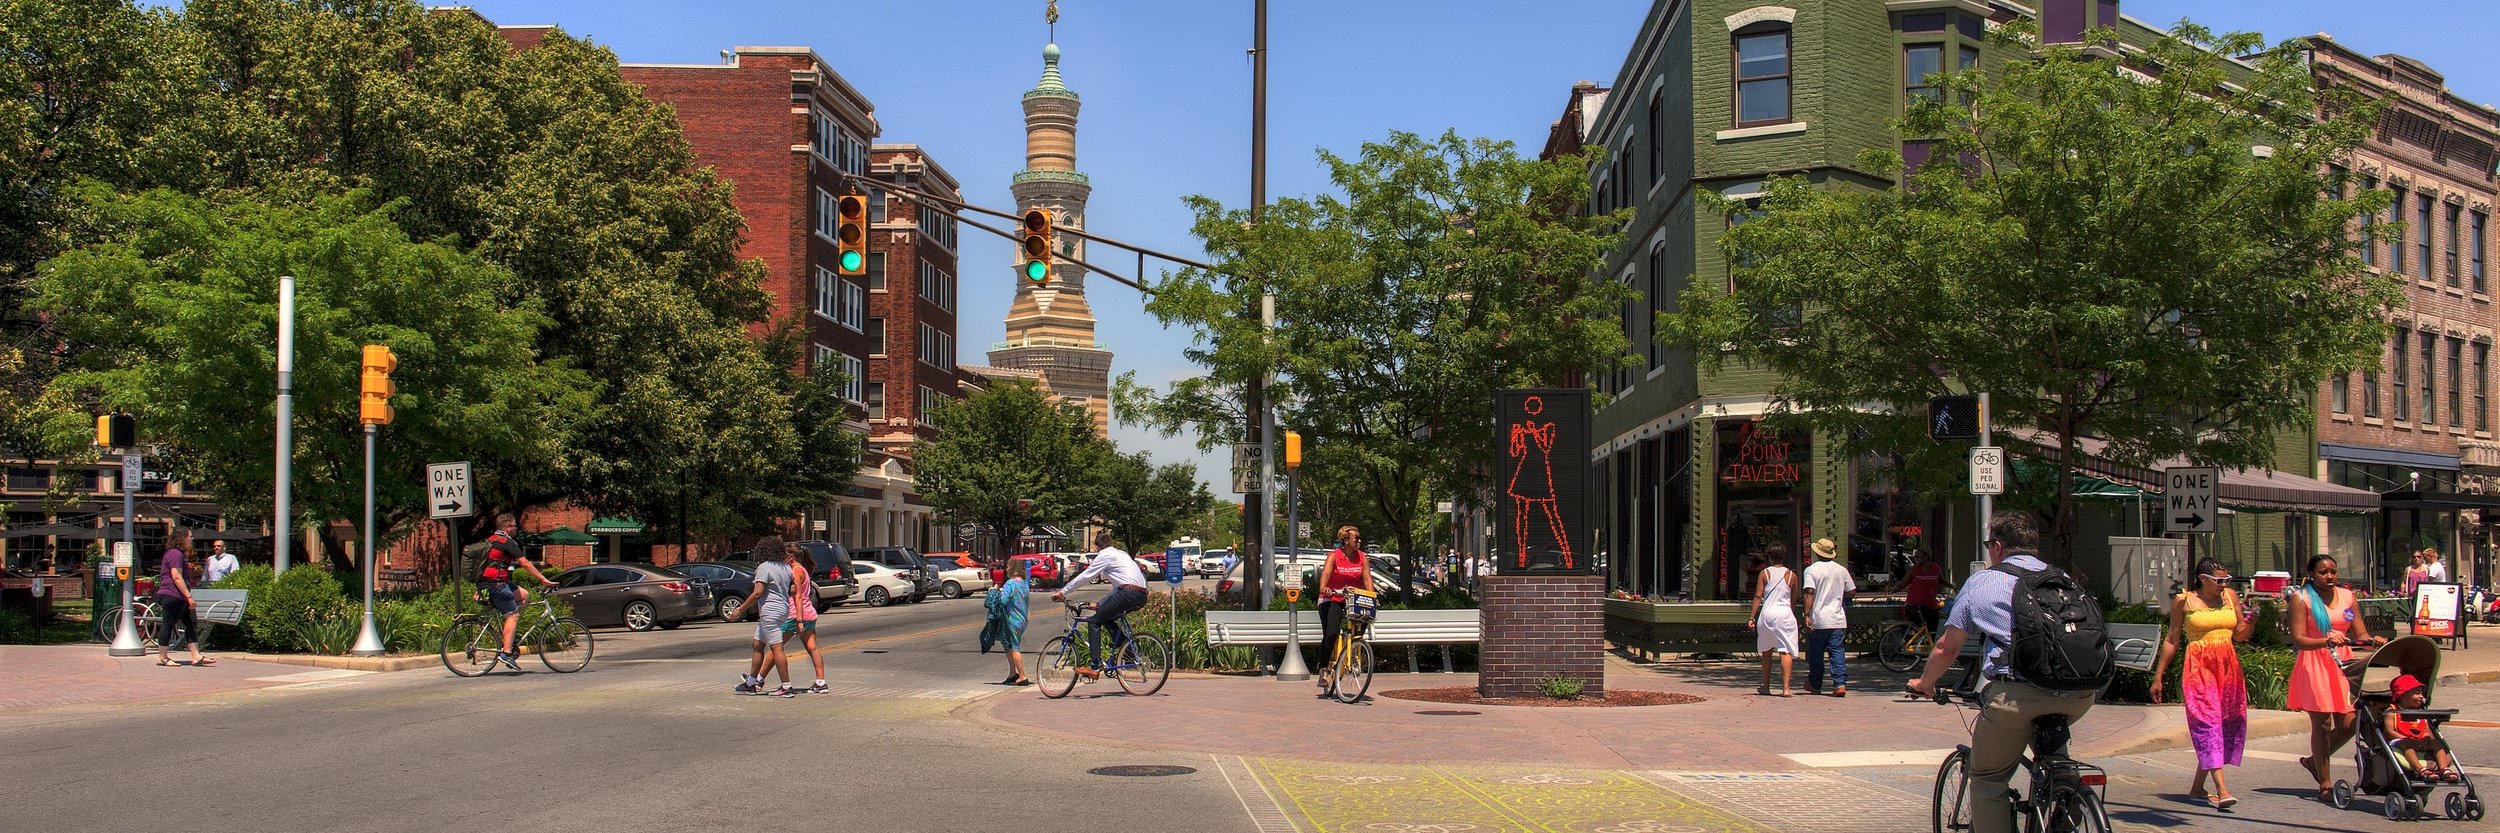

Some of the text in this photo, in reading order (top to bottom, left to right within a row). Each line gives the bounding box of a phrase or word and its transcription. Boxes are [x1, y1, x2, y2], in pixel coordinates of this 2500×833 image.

[1244, 447, 1261, 457] NO
[1741, 442, 1792, 463] POINT
[1242, 460, 1259, 468] TUR
[434, 468, 464, 482] ONE
[1246, 470, 1259, 479] ON
[1730, 463, 1799, 482] TAVERN
[1244, 481, 1261, 489] RED
[2172, 474, 2209, 489] ONE
[434, 485, 465, 499] WAY
[2171, 494, 2211, 510] WAY
[1299, 529, 1309, 537] 25
[1720, 527, 1729, 585] LIQUORS
[2430, 620, 2449, 628] PICK
